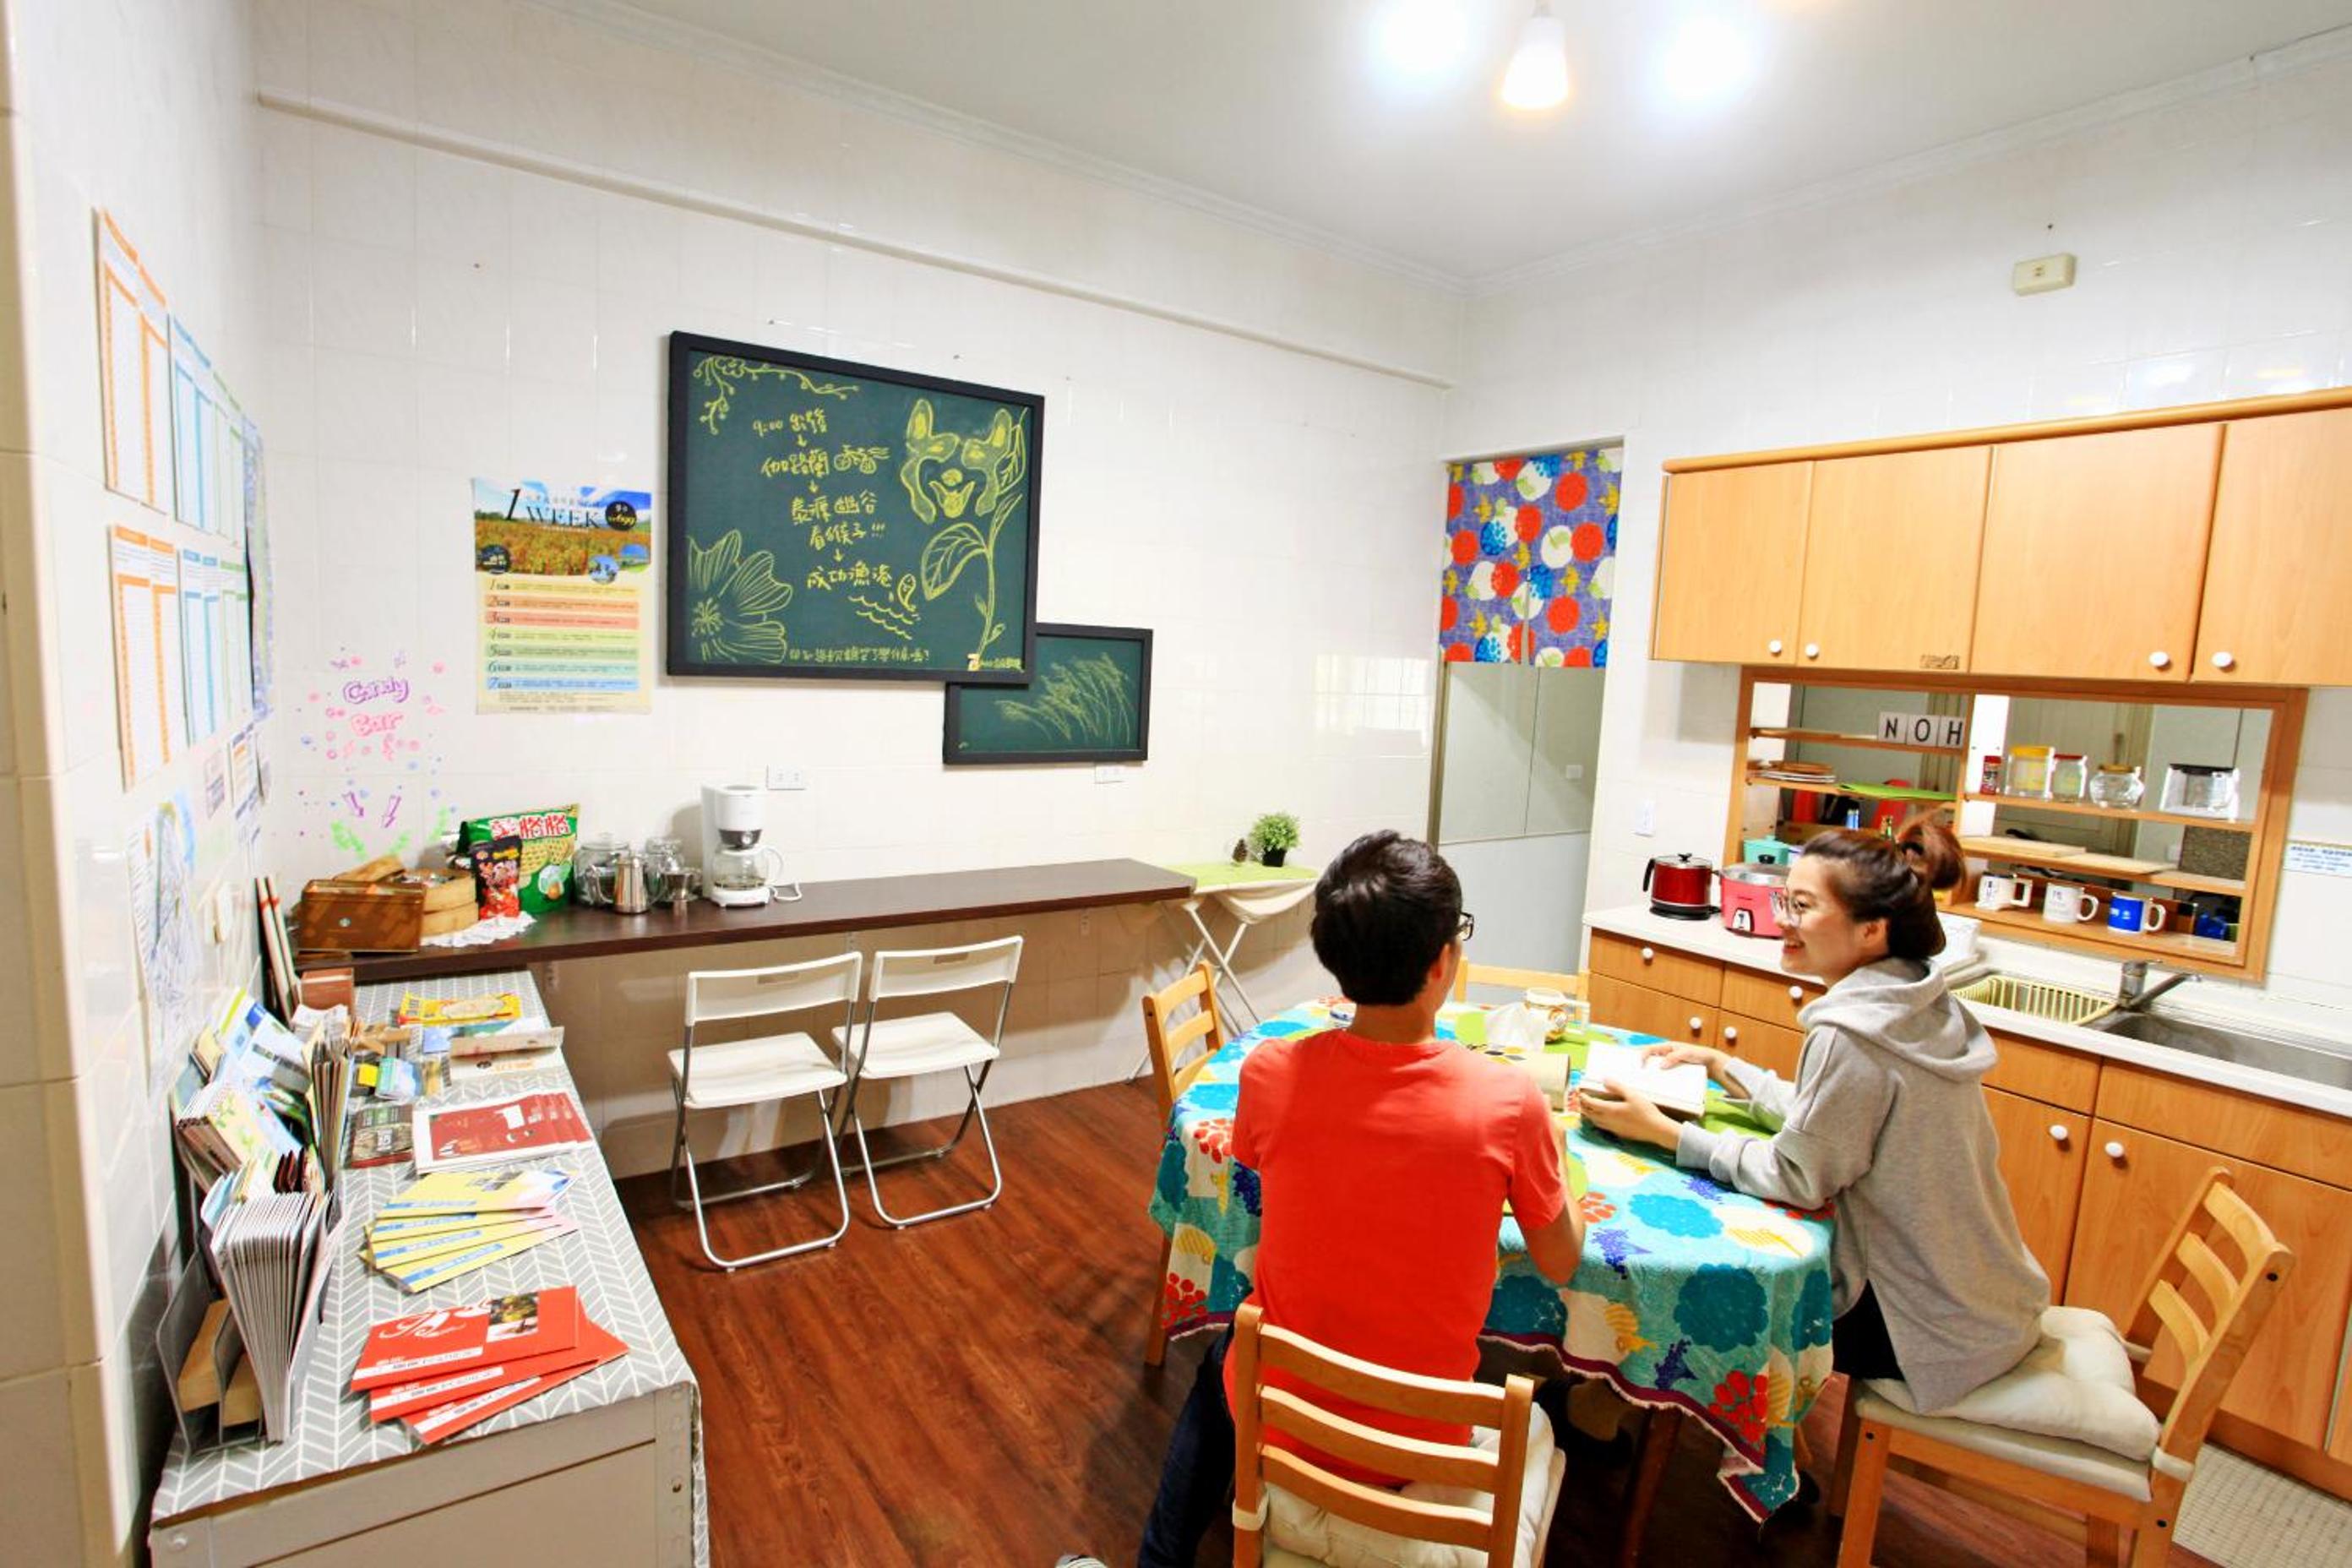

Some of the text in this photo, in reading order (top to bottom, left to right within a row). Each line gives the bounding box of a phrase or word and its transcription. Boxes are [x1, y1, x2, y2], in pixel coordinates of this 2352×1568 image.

[505, 488, 521, 521] 1
[525, 506, 603, 529] WEEK
[343, 676, 410, 704] Candy
[351, 712, 405, 738] Bar
